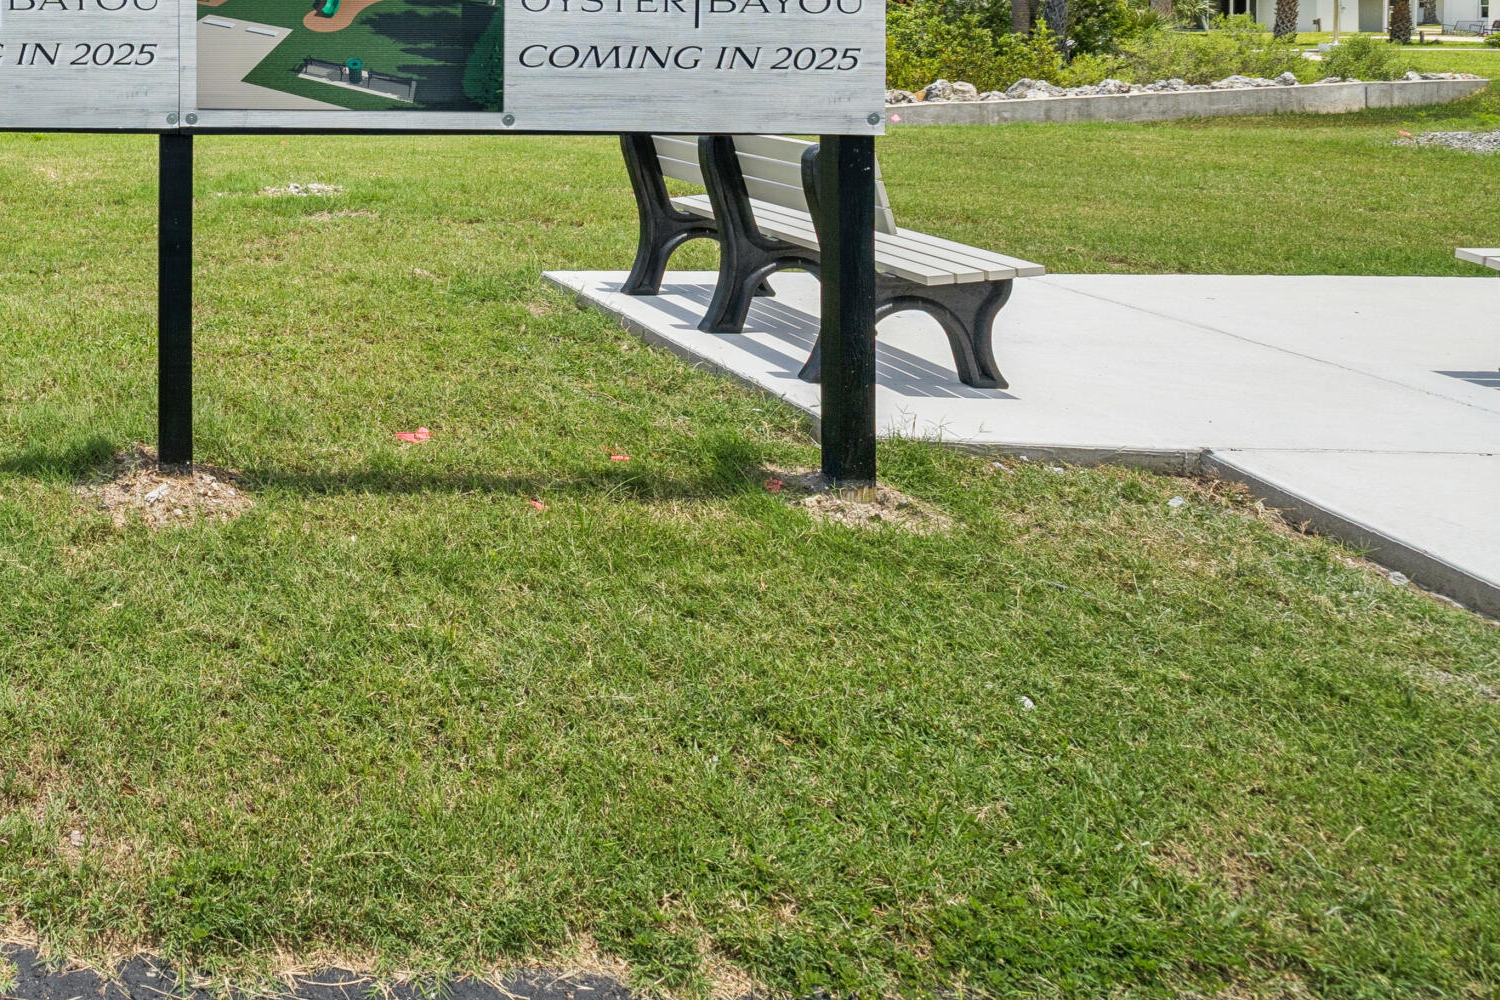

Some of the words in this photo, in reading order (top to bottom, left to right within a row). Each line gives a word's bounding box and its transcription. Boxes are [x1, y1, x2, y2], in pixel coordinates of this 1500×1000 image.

[16, 42, 61, 66] IN
[69, 43, 158, 66] 2025
[518, 44, 703, 70] COMING
[715, 46, 762, 70] IN
[770, 46, 861, 71] 2025
